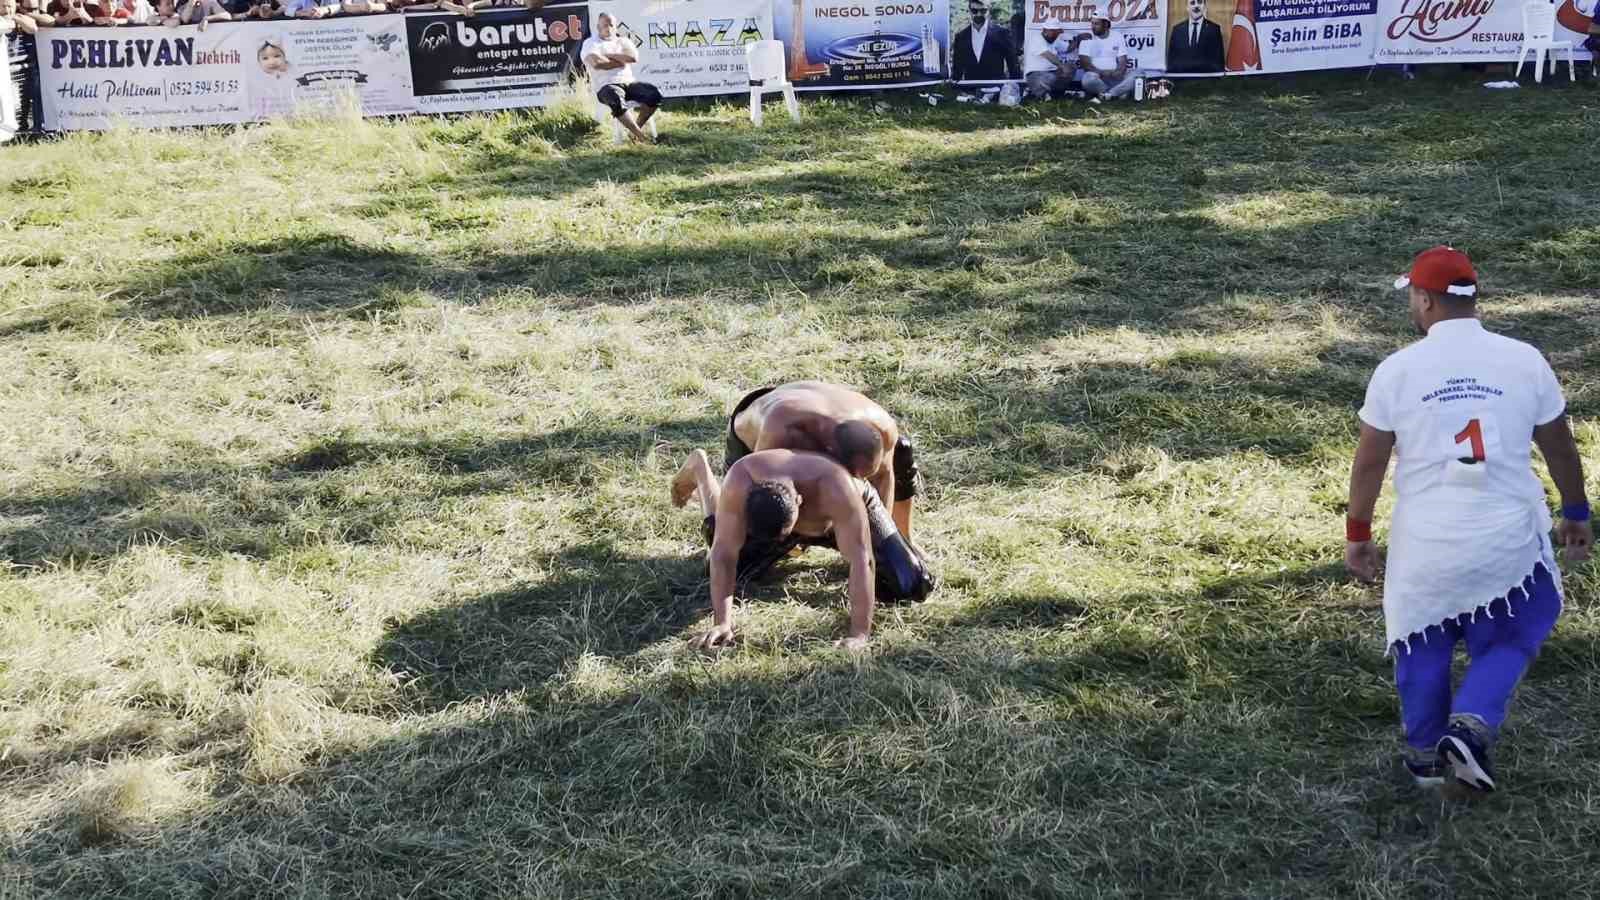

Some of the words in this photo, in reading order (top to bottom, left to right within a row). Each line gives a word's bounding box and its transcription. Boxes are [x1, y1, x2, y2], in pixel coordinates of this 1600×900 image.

[875, 3, 934, 16] SONDAJ
[456, 14, 583, 47] barutet
[648, 17, 763, 49] NAZA
[1271, 26, 1317, 47] Şahin
[195, 50, 241, 65] Elektrik
[477, 49, 519, 60] entegre
[521, 44, 565, 56] tesisleri
[57, 81, 99, 99] Halil
[102, 80, 161, 102] Pehlivan
[1454, 418, 1486, 462] 1
